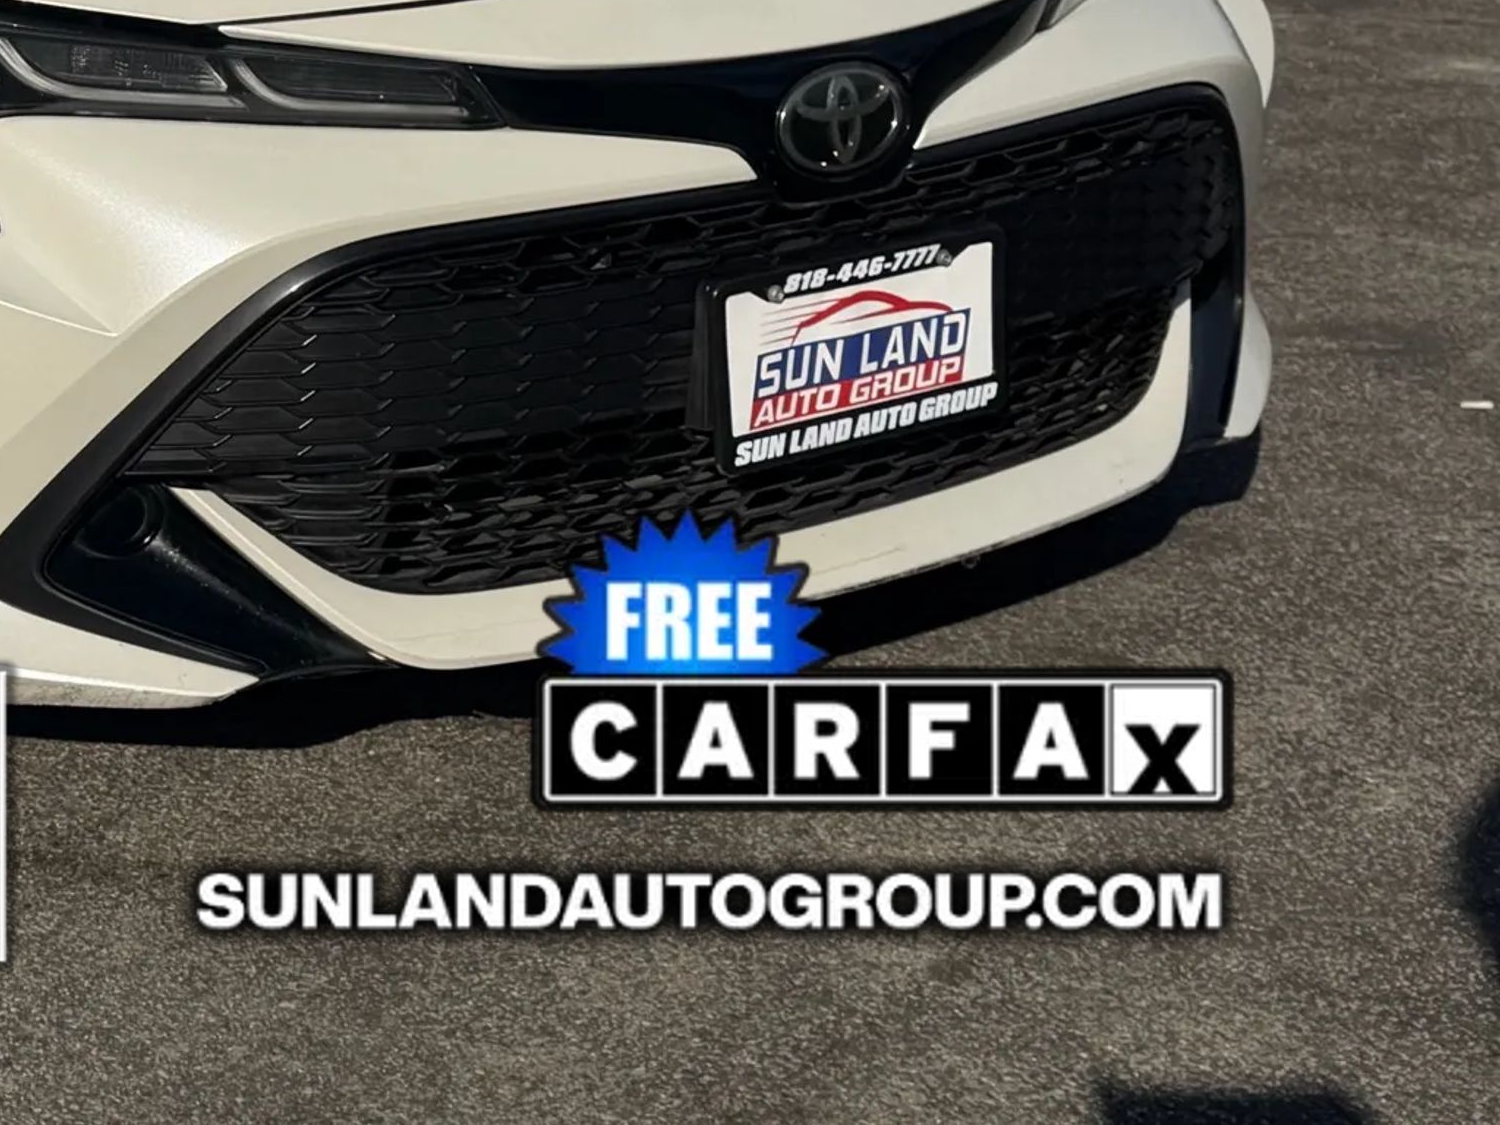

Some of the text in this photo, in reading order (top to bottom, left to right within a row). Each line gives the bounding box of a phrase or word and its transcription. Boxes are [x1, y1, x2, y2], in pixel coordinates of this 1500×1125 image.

[783, 242, 941, 294] 818-446-7777
[754, 355, 961, 428] AUTO GROUP
[757, 312, 966, 398] SUN LAND
[734, 381, 998, 467] SUN LAND AUTO GROUP
